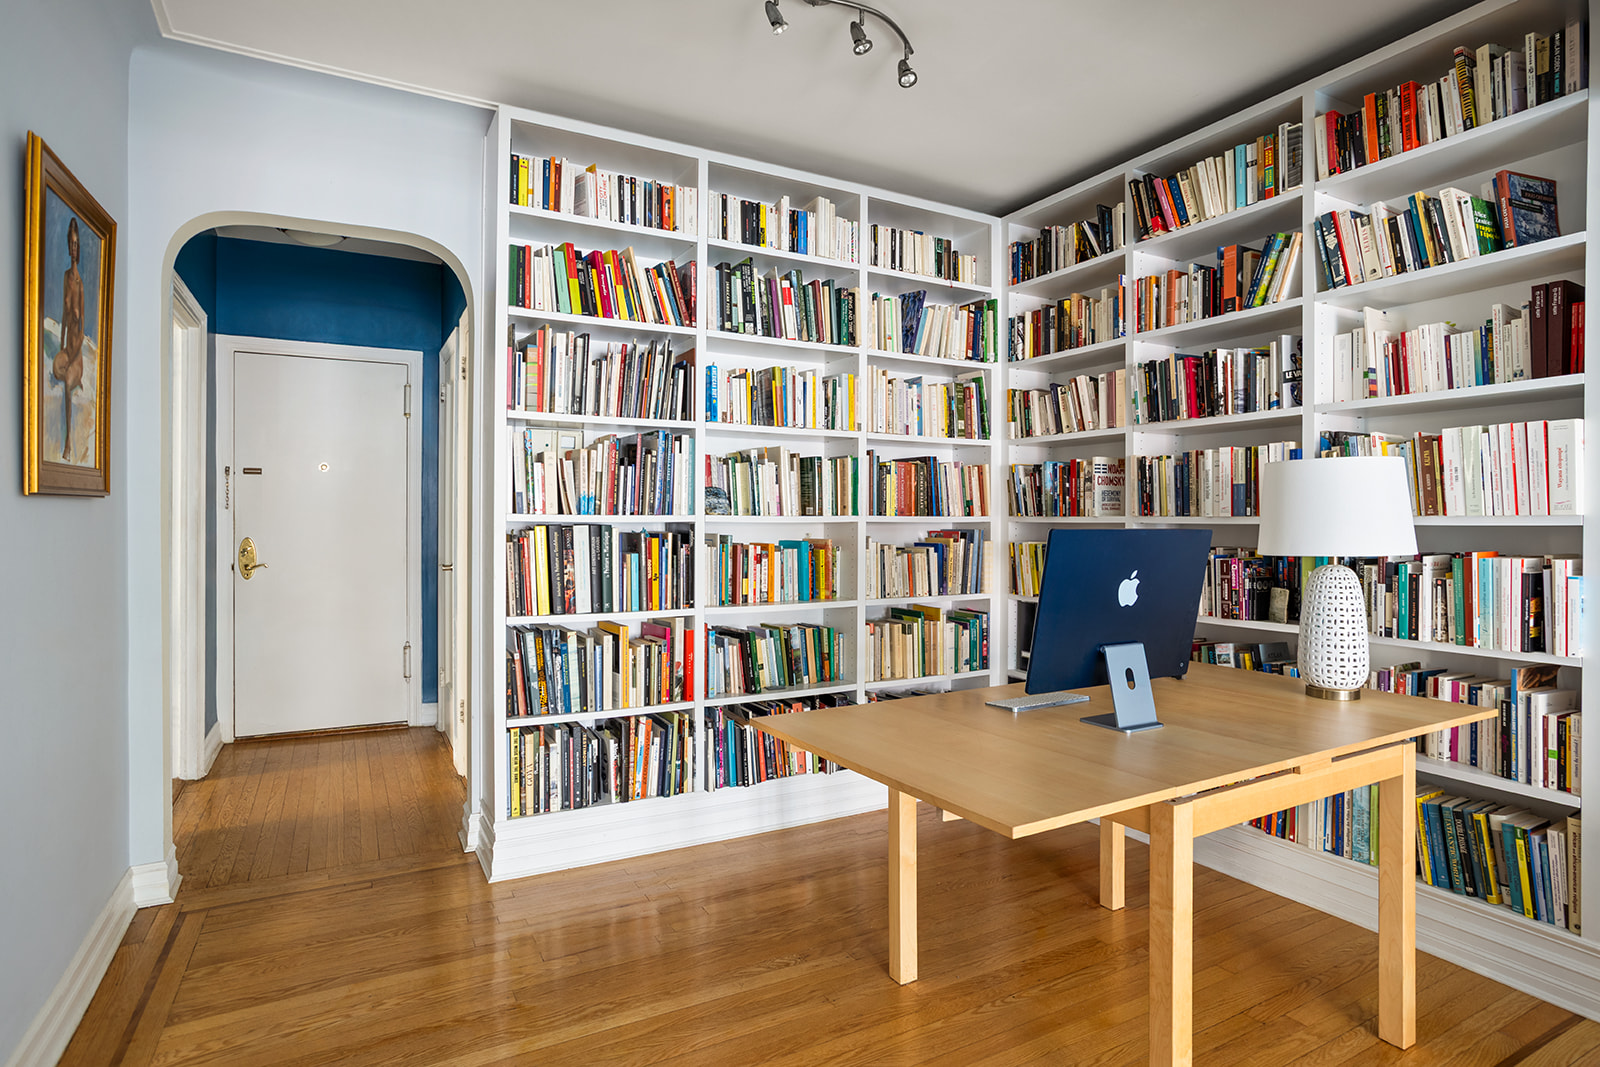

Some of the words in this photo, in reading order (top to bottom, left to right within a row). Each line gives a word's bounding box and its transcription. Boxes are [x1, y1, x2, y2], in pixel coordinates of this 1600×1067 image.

[1474, 210, 1488, 219] Alice
[1361, 228, 1370, 253] LEIRIS
[1097, 476, 1125, 486] CHOMSKY
[1446, 821, 1456, 858] ATLANTIC
[1452, 858, 1460, 885] WORLD
